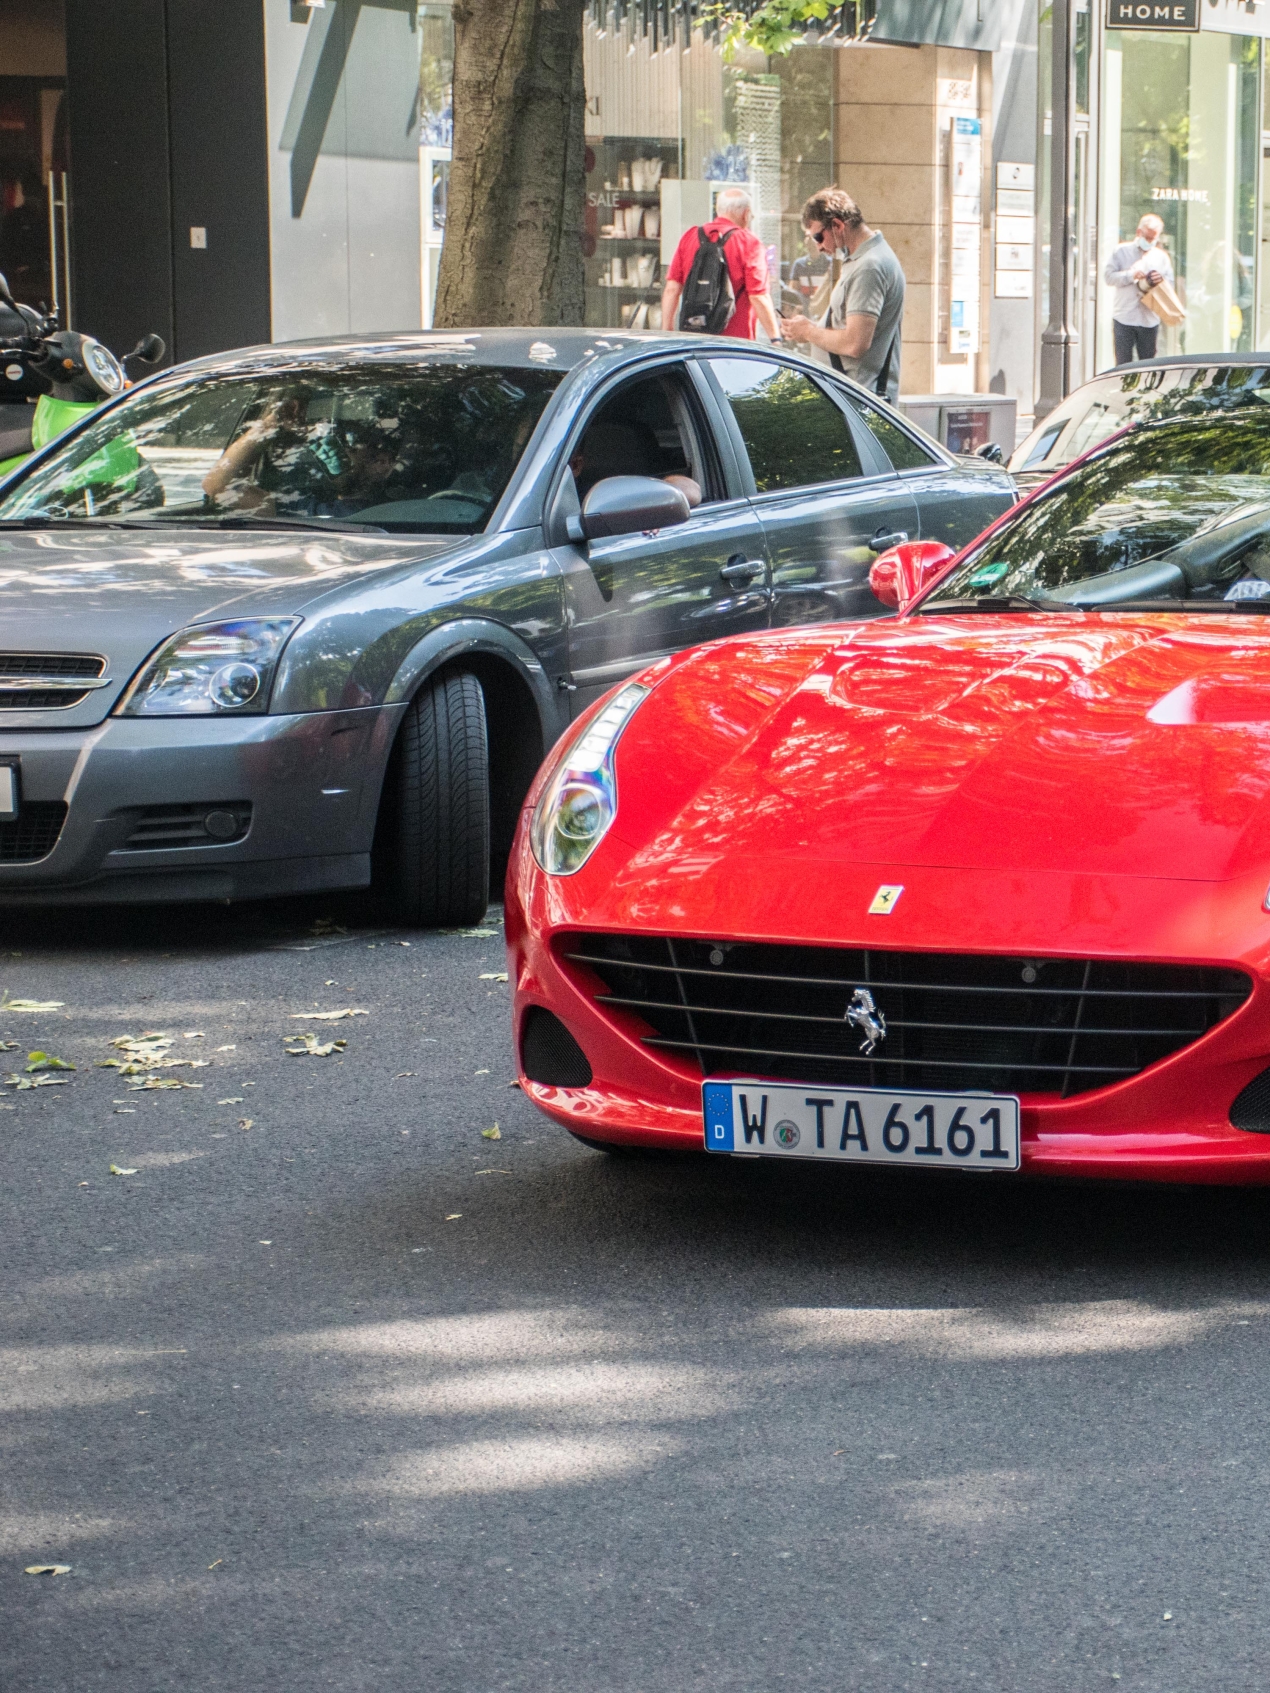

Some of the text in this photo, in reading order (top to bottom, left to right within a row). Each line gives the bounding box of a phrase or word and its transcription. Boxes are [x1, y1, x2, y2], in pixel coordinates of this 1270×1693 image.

[1119, 5, 1186, 20] HOME
[588, 192, 620, 207] SALE
[1151, 187, 1179, 200] ZARA
[714, 1094, 1009, 1159] D W TA 6161
